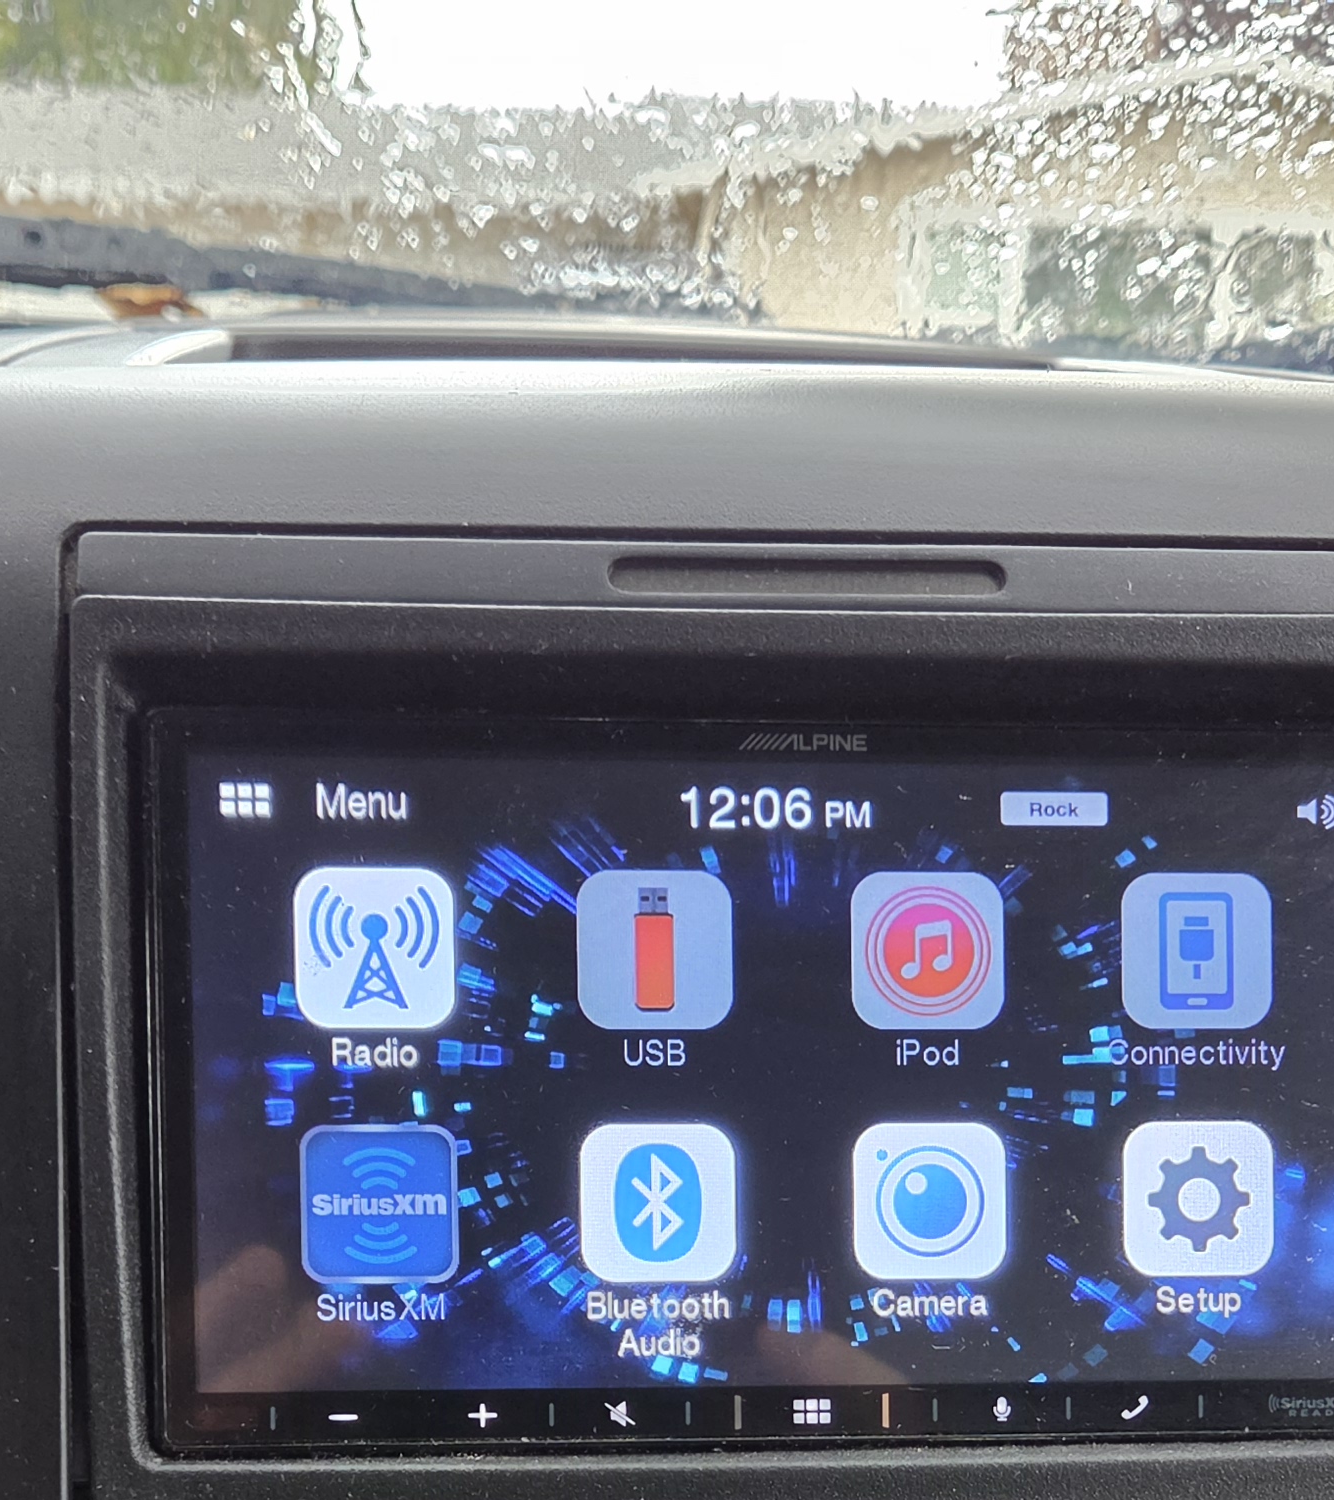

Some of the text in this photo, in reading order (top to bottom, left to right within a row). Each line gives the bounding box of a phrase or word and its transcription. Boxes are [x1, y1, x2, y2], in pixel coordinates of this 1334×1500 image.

[778, 733, 868, 752] ALPINE
[315, 783, 408, 820] Menu
[680, 786, 873, 830] 12:06 PM
[1029, 802, 1079, 818] Rock
[332, 1038, 418, 1068] Radio
[624, 1039, 686, 1067] USB
[896, 1039, 960, 1066] iPod
[1110, 1039, 1285, 1070] Connectivity
[316, 1294, 446, 1322] SiriusXM
[587, 1291, 731, 1320] Bluetooth
[872, 1289, 987, 1317] Camera
[1155, 1288, 1242, 1318] Setup
[617, 1329, 700, 1358] Audio
